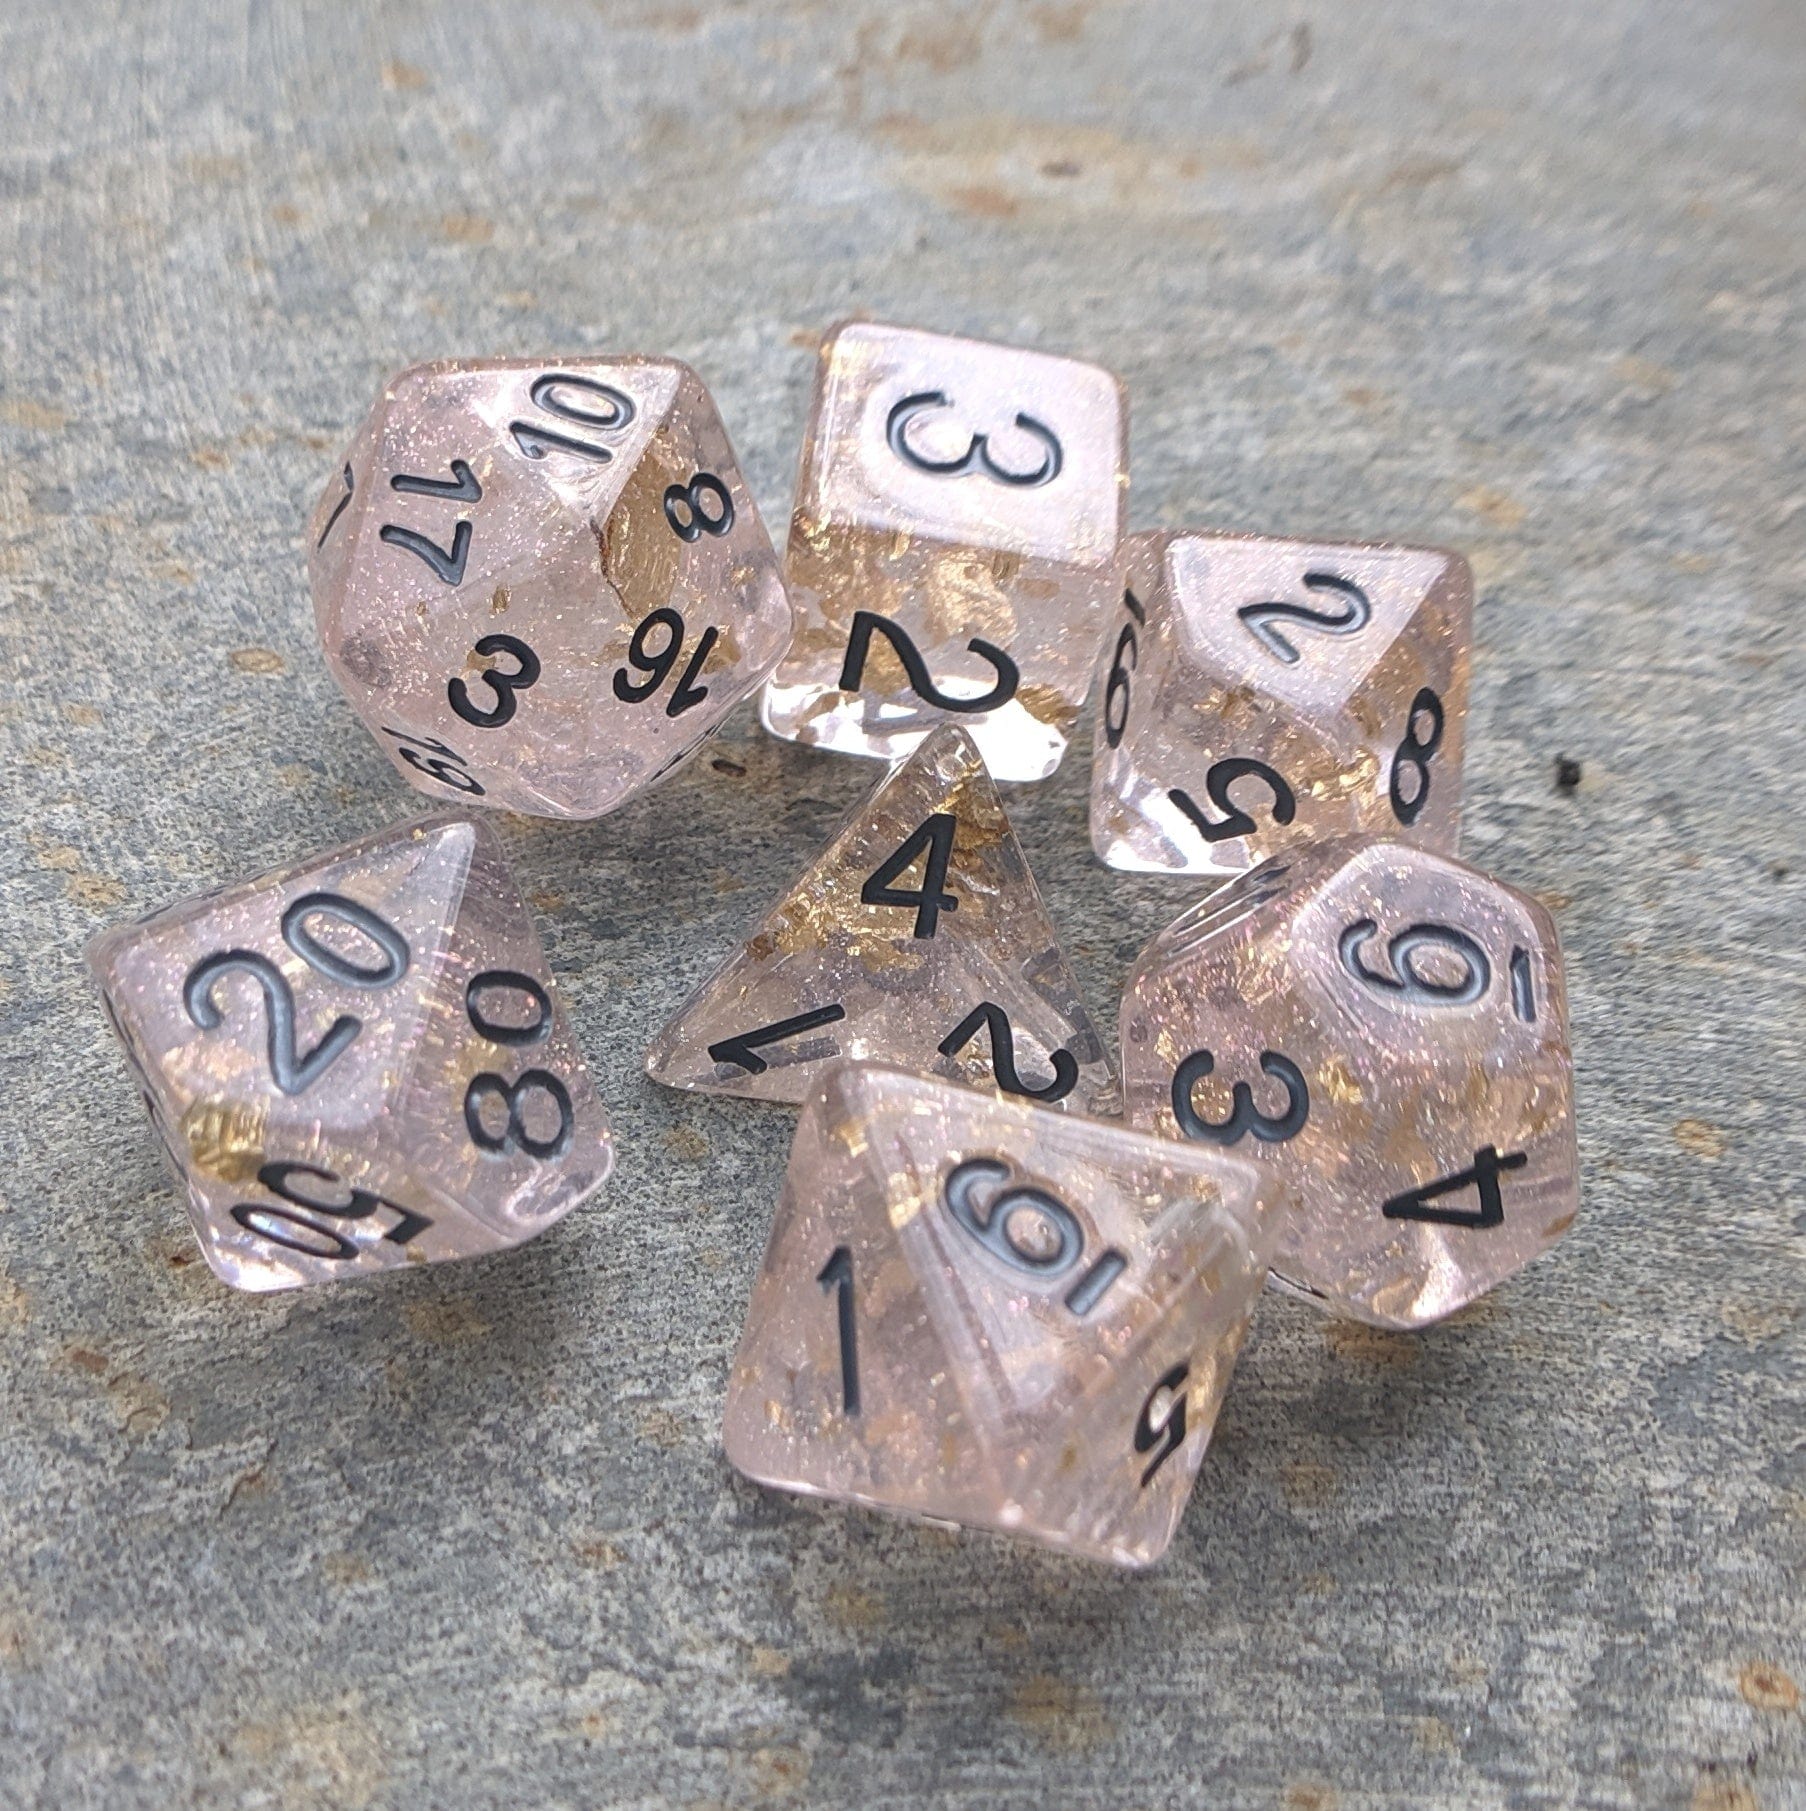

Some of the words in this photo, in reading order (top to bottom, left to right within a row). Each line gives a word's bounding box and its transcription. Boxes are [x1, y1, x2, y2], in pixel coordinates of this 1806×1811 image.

[509, 372, 637, 464] 10
[886, 390, 1064, 488] 3
[380, 459, 483, 587] 17
[664, 473, 735, 543] 8
[613, 608, 719, 718] 16
[839, 611, 1020, 713] 2
[1238, 572, 1371, 664] 2
[448, 634, 541, 728] 3
[1168, 758, 1296, 843] 5
[1390, 687, 1445, 828] 8
[860, 813, 959, 939] 4
[183, 892, 411, 1096] 20
[708, 1003, 846, 1075] 1
[464, 970, 574, 1161] 80
[938, 1001, 1079, 1102] 2
[1171, 1049, 1310, 1146] 3
[230, 1161, 434, 1260] 50
[1382, 1143, 1528, 1229] 4
[817, 1245, 861, 1417] 1
[1133, 1360, 1189, 1488] 5
